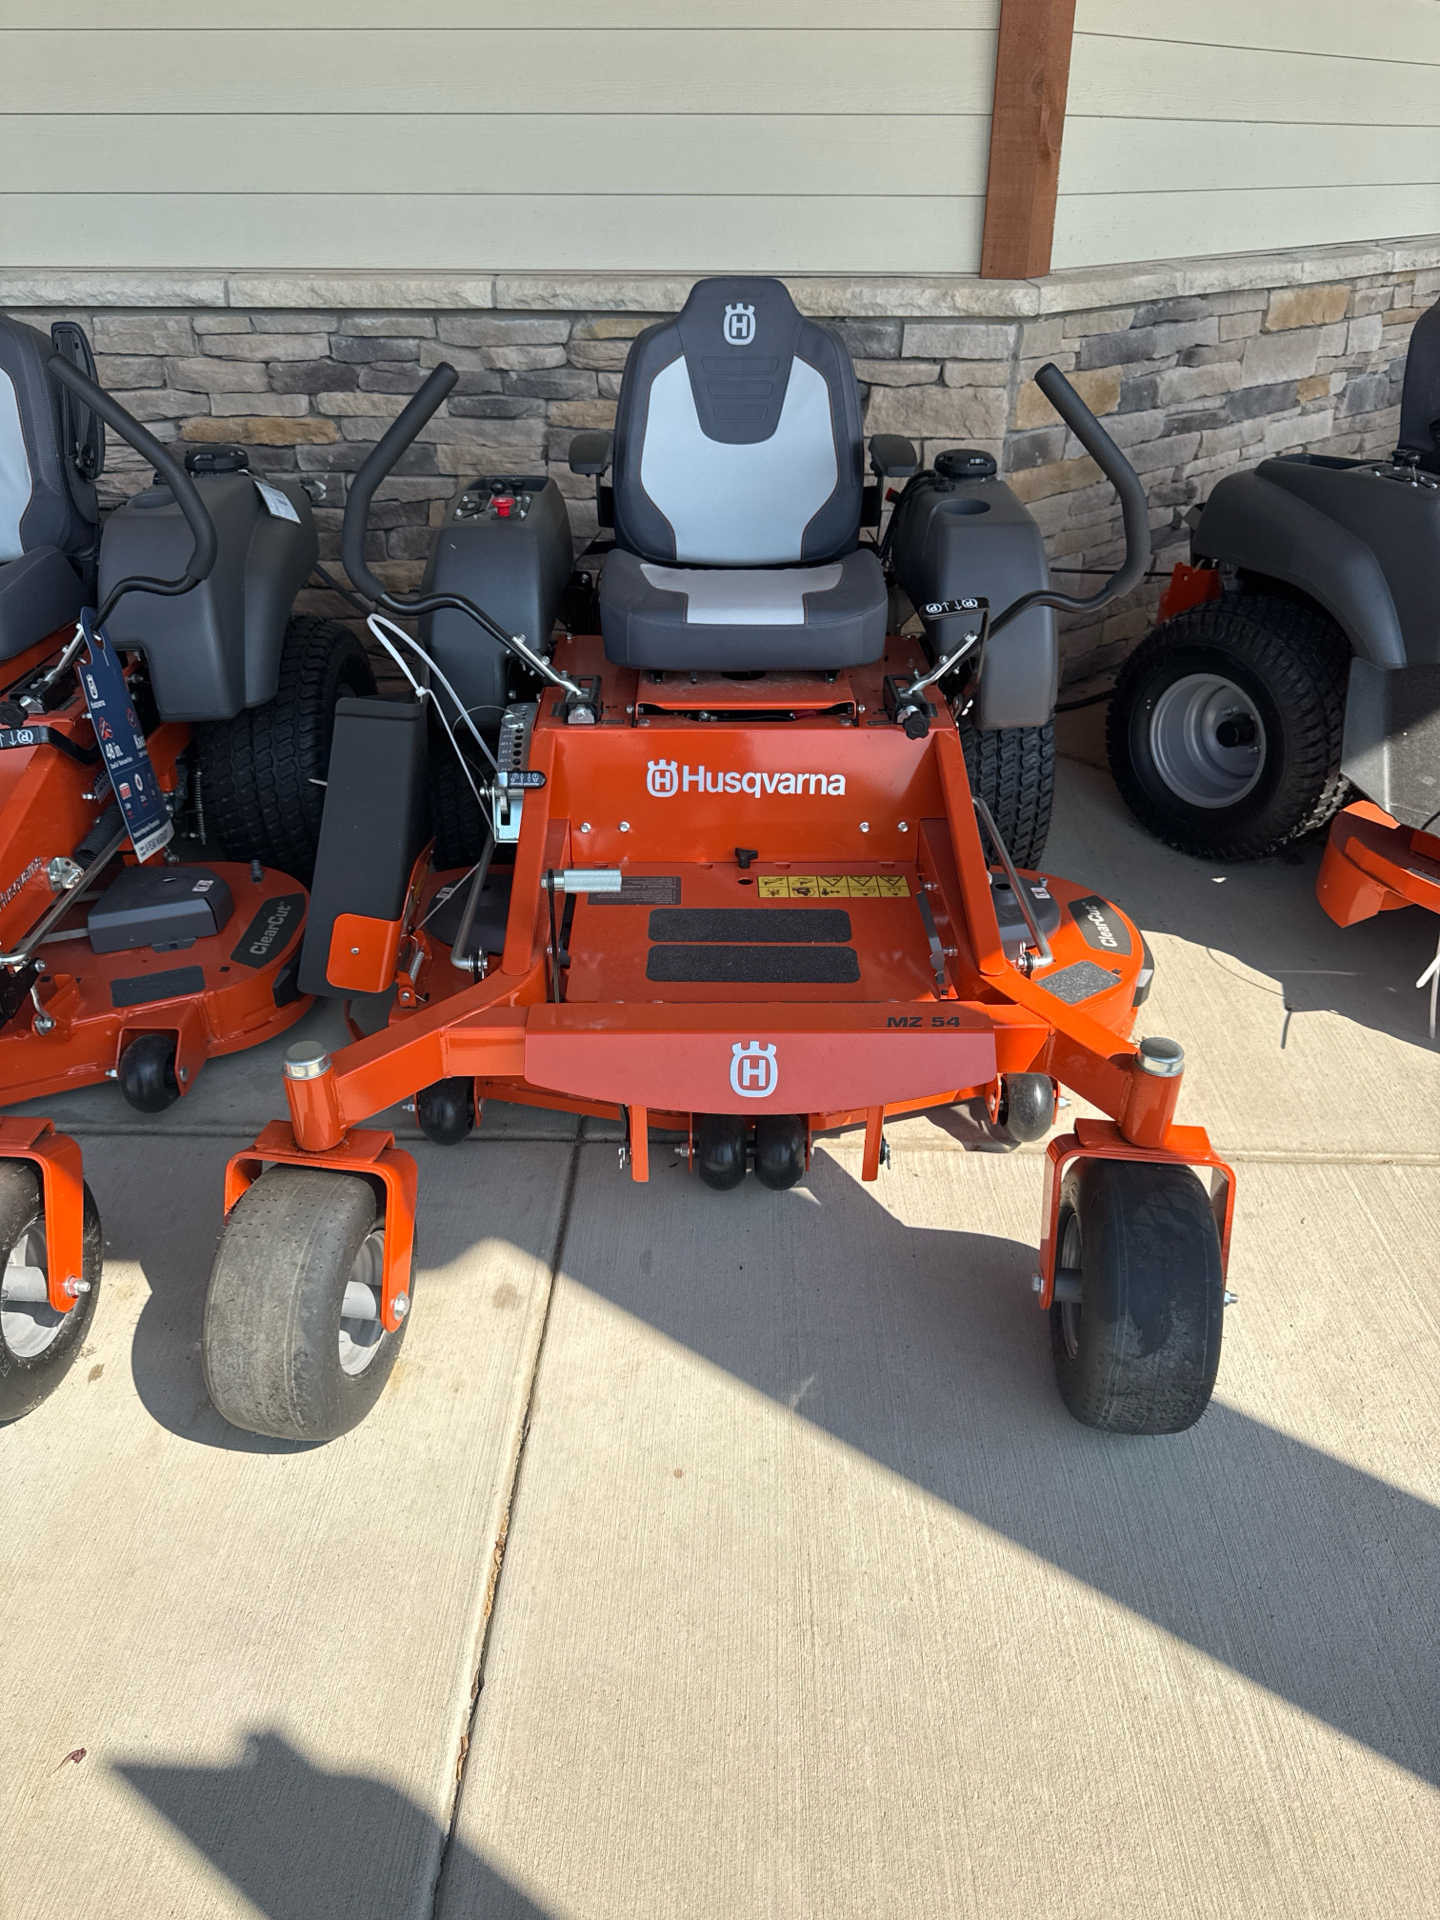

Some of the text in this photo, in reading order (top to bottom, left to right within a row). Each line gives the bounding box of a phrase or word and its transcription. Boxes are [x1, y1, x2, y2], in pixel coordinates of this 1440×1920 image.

[682, 765, 846, 798] Husqvarna
[887, 1016, 960, 1028] MZ 54
